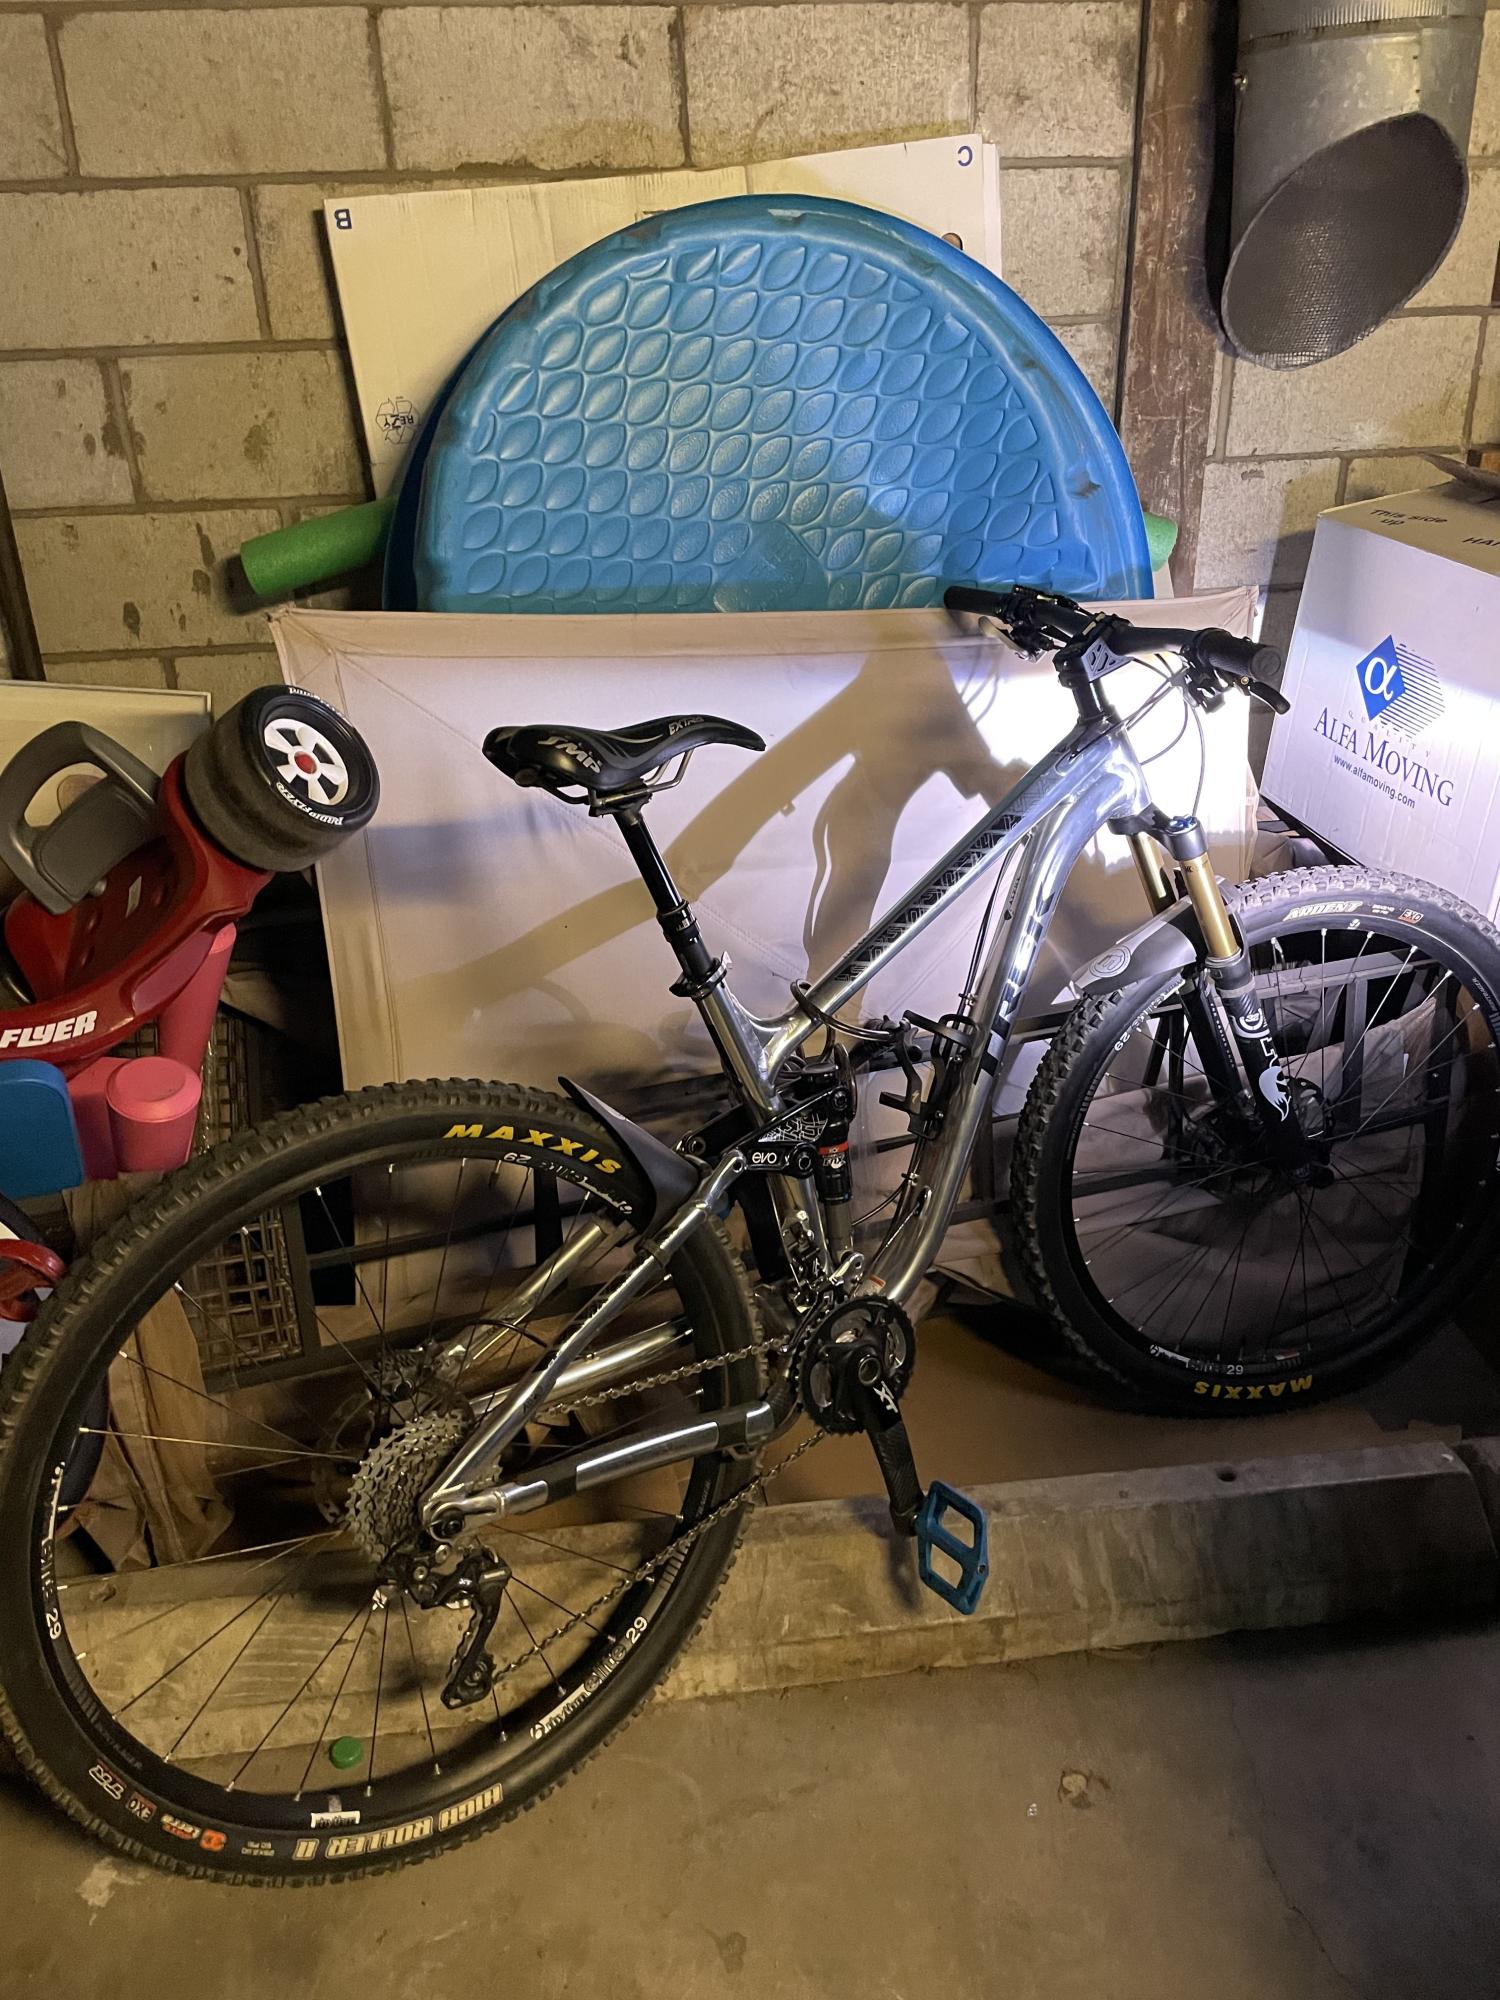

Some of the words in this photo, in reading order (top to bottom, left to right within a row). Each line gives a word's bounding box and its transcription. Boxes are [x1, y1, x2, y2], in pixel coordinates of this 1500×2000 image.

[334, 208, 352, 230] B
[1370, 509, 1406, 518] This
[1408, 515, 1448, 523] side
[1381, 518, 1405, 526] up
[1463, 537, 1500, 547] HA
[1313, 706, 1358, 755] ALFA
[1362, 731, 1454, 807] MOVING
[1334, 754, 1416, 809] www.alfamoving.com
[0, 1010, 98, 1049] FLYER
[443, 1124, 622, 1174] MAXXIS
[503, 1152, 532, 1164] 29
[1226, 1364, 1244, 1375] 29
[1194, 1374, 1312, 1400] MAXXIS
[45, 1607, 62, 1640] 29
[626, 1616, 648, 1644] 29
[325, 1815, 433, 1859] ROLLER
